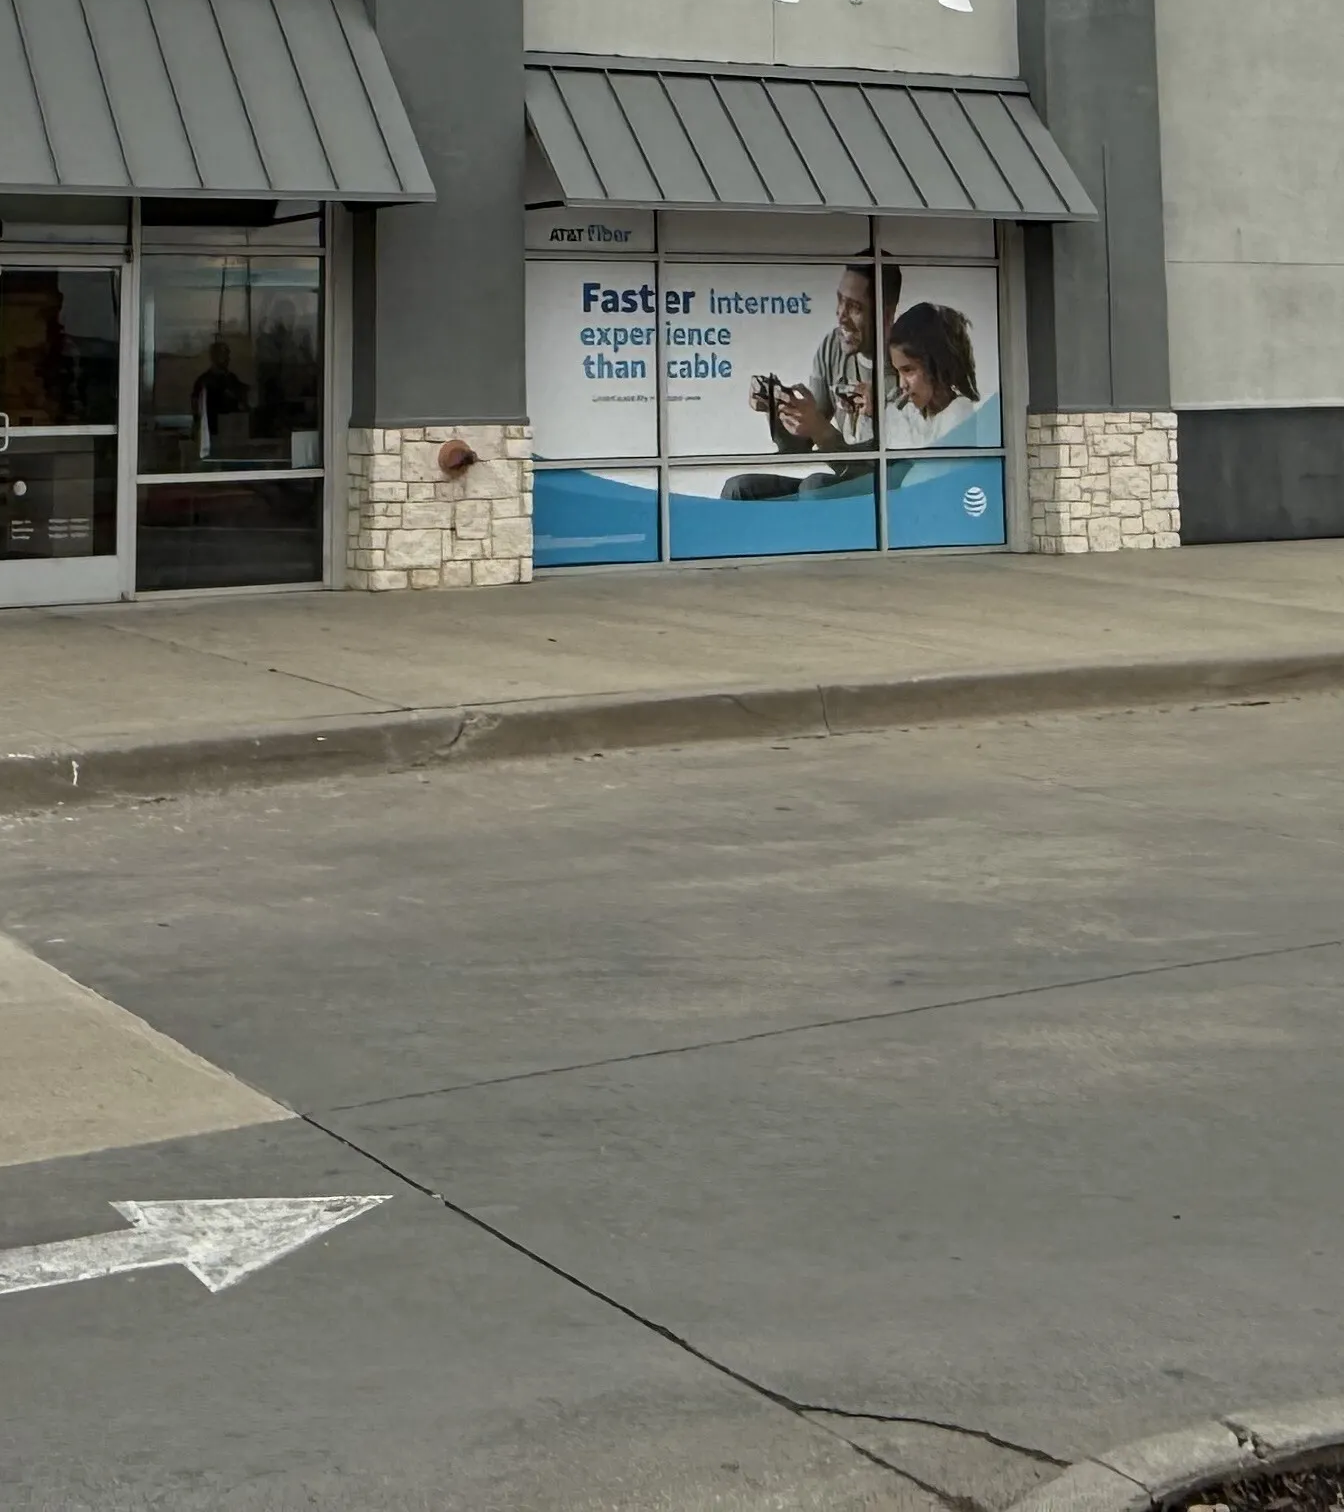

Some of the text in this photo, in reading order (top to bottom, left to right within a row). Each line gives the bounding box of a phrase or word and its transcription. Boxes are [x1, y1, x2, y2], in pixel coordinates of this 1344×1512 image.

[582, 283, 812, 314] Faster internet
[580, 321, 731, 352] experience
[582, 353, 732, 379] than cable
